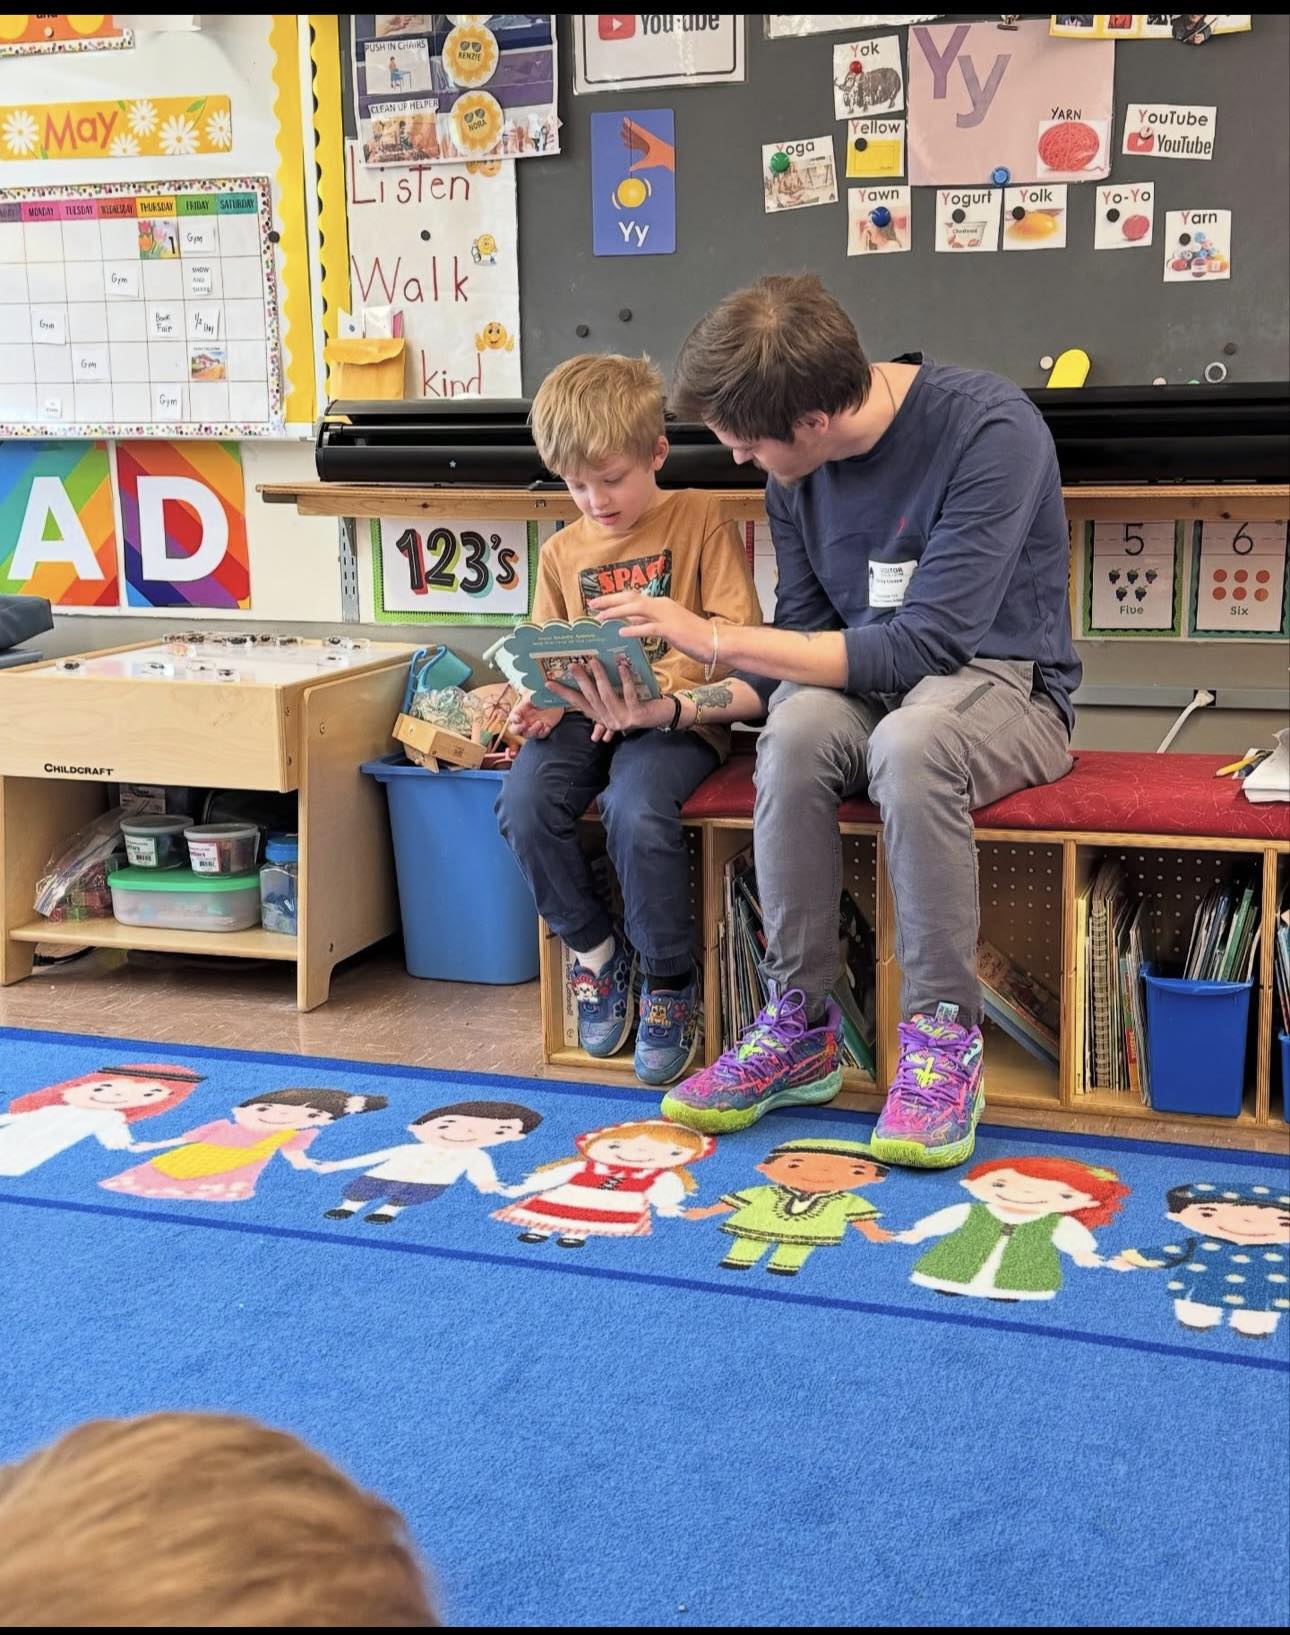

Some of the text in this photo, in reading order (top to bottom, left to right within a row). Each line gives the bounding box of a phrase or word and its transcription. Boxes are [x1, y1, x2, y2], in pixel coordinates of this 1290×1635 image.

[640, 15, 721, 36] Youube
[364, 39, 426, 53] PUSH IN CHAIRS
[371, 99, 439, 114] CLEAN UP HELPER
[1051, 106, 1082, 121] YARN
[1138, 109, 1209, 127] YouTube
[44, 110, 118, 151] May
[851, 121, 901, 136] Yellow
[1157, 134, 1212, 156] YouTube
[858, 188, 900, 203] Yawn
[941, 190, 993, 209] Yogurt
[1019, 189, 1053, 204] Yolk
[1102, 188, 1152, 206] Yo-Yo
[28, 207, 55, 217] MONDAY
[65, 205, 94, 216] TUESDAY
[100, 204, 134, 215] WEDNESDAY
[139, 202, 174, 213] THURSDAY
[185, 200, 210, 211] FRIDAY
[219, 199, 255, 210] SATURDAY
[1180, 211, 1218, 226] Yarn
[186, 232, 204, 245] Gym
[618, 221, 650, 248] Yy
[111, 272, 129, 285] Gym
[351, 255, 470, 304] Walk
[39, 318, 56, 331] Gym
[80, 359, 98, 369] Gym
[421, 349, 483, 398] kind
[159, 393, 178, 407] Gym
[1124, 522, 1145, 556] 5
[1232, 521, 1254, 556] 6
[396, 528, 520, 599] 123's
[1119, 604, 1144, 615] Five
[1230, 606, 1249, 616] Six
